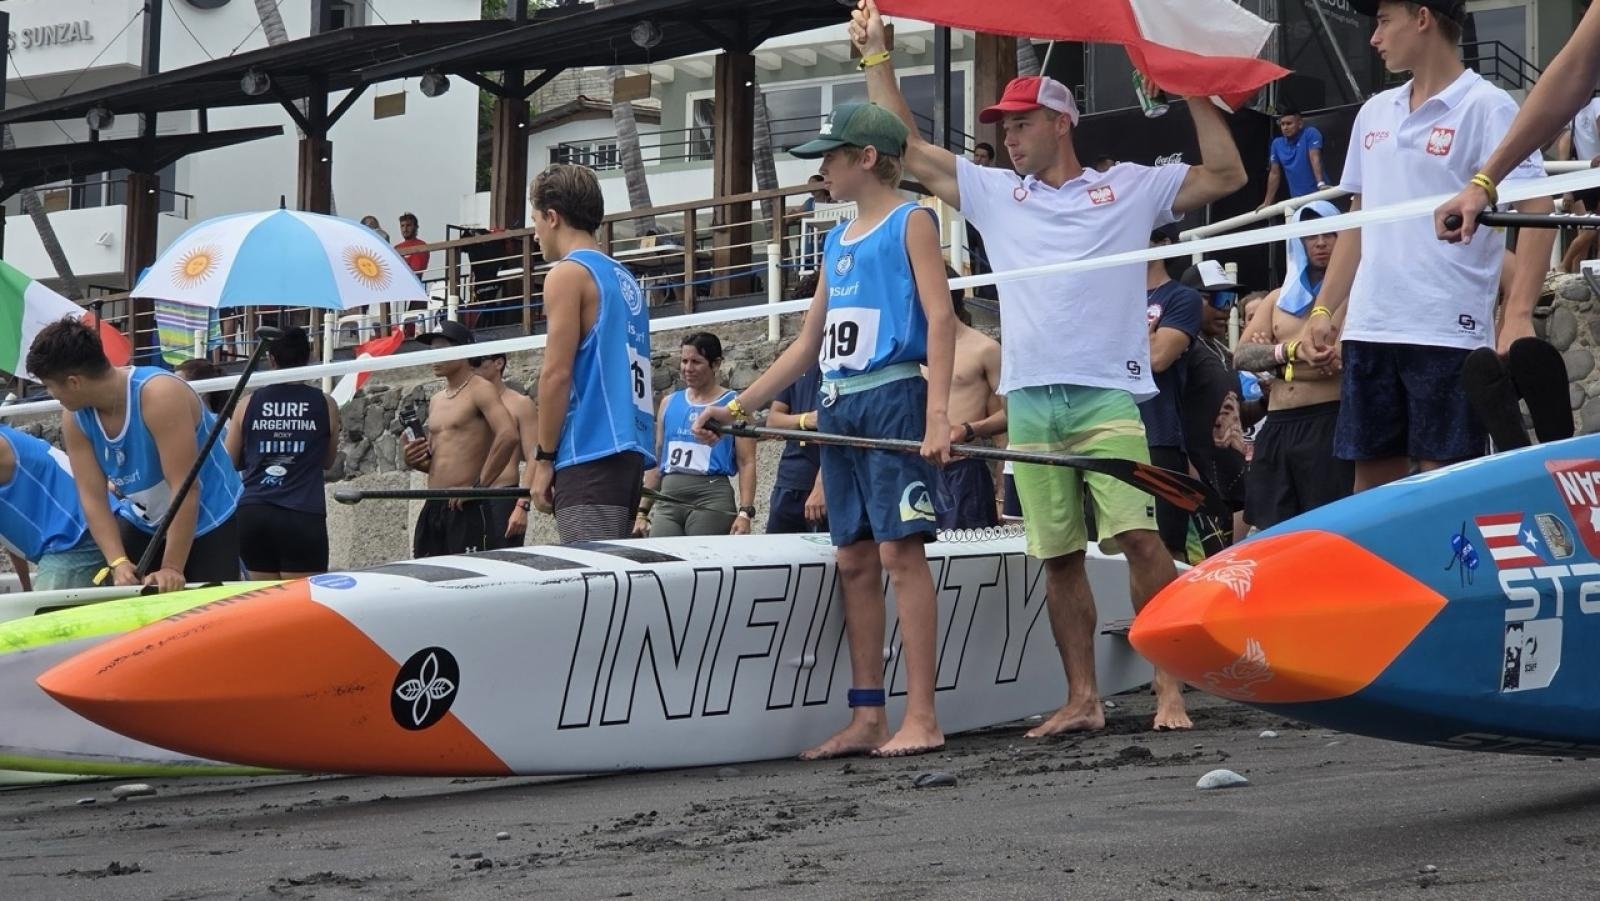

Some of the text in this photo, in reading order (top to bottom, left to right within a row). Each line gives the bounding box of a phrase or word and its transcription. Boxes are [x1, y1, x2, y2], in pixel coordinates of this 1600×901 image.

[22, 20, 94, 50] SUNZAL
[823, 321, 859, 361] 19
[261, 402, 310, 417] SURF
[252, 419, 317, 431] ARGENTINA
[670, 448, 693, 467] 91
